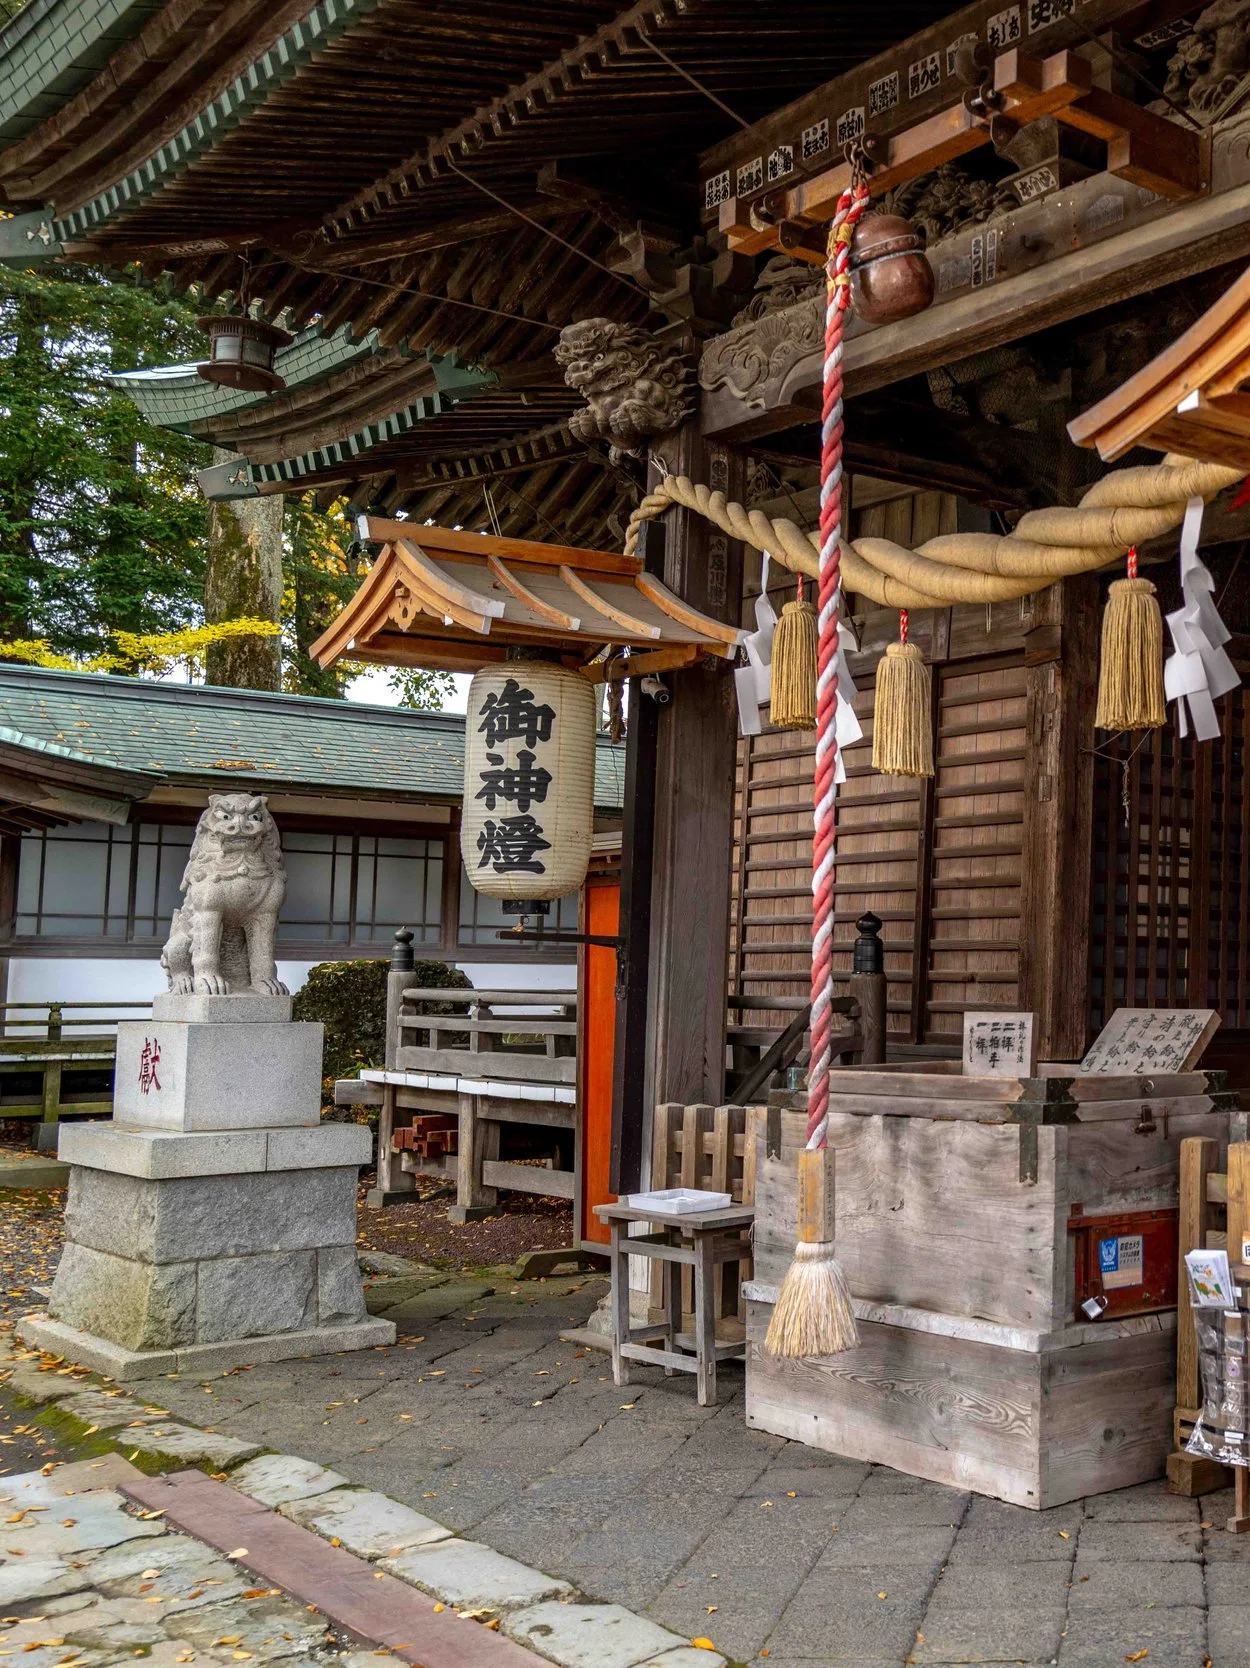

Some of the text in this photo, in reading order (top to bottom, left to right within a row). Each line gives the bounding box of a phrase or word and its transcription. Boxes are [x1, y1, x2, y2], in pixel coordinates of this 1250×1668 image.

[474, 678, 557, 875] 御神燈
[988, 1022, 1002, 1069] 二拍手
[1001, 1022, 1016, 1053] 二拝
